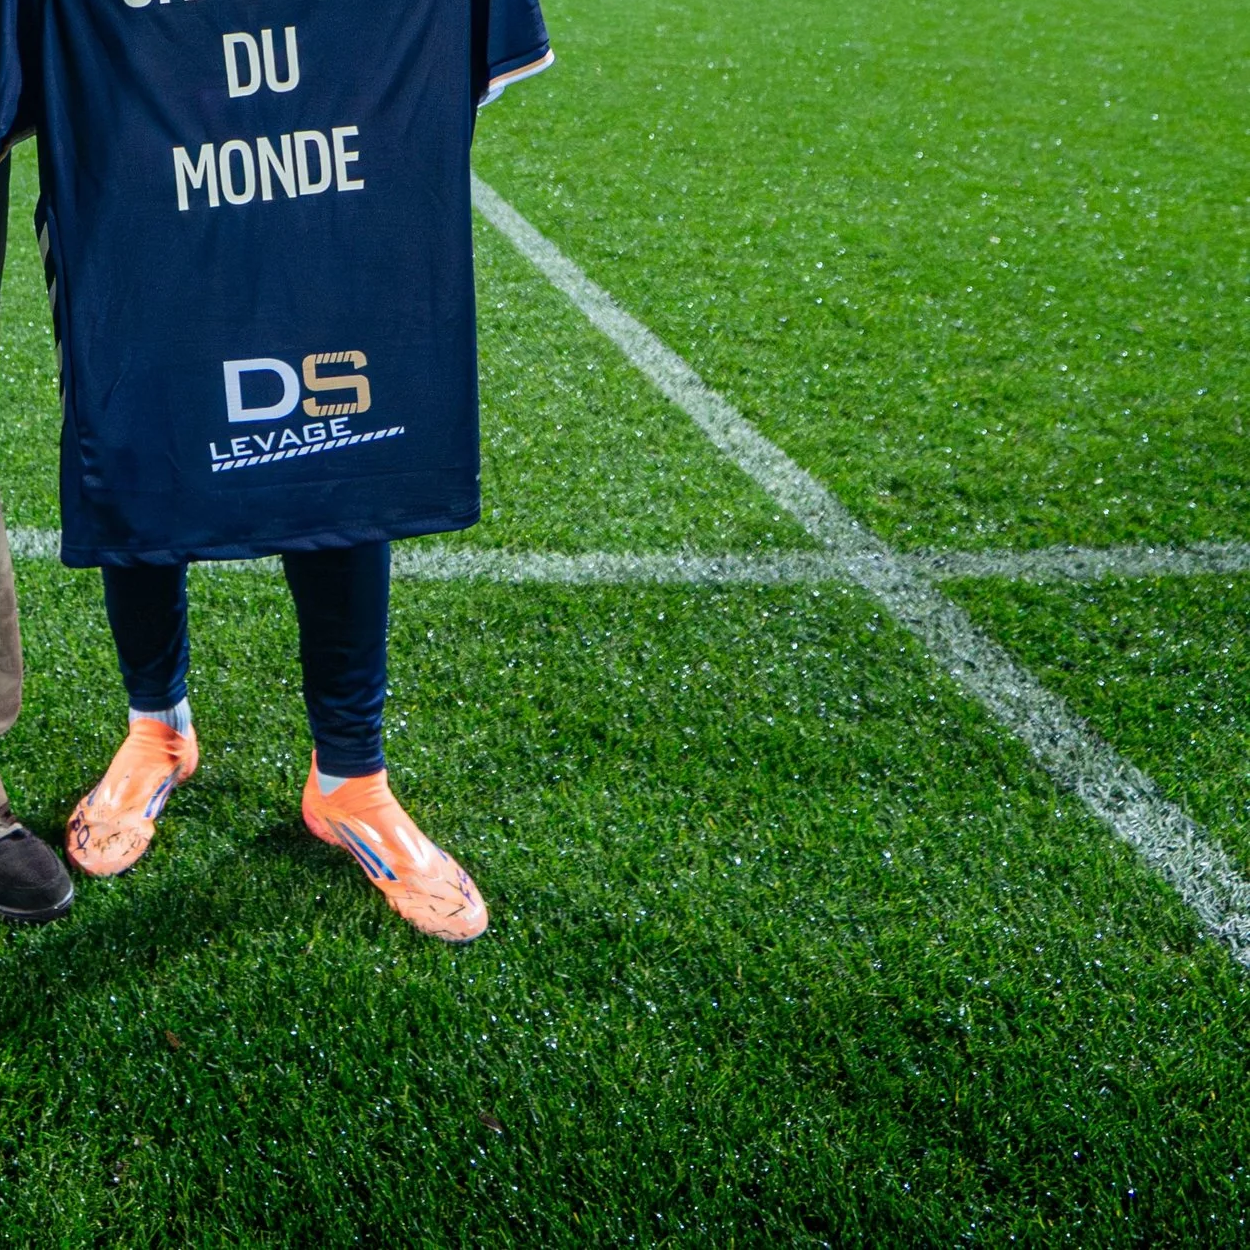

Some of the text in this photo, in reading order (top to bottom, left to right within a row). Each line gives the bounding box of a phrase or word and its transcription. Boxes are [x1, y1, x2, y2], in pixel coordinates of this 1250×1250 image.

[223, 26, 300, 99] DU
[172, 125, 365, 211] MONDE
[222, 349, 372, 423] DS
[209, 416, 353, 461] LEVAGE
